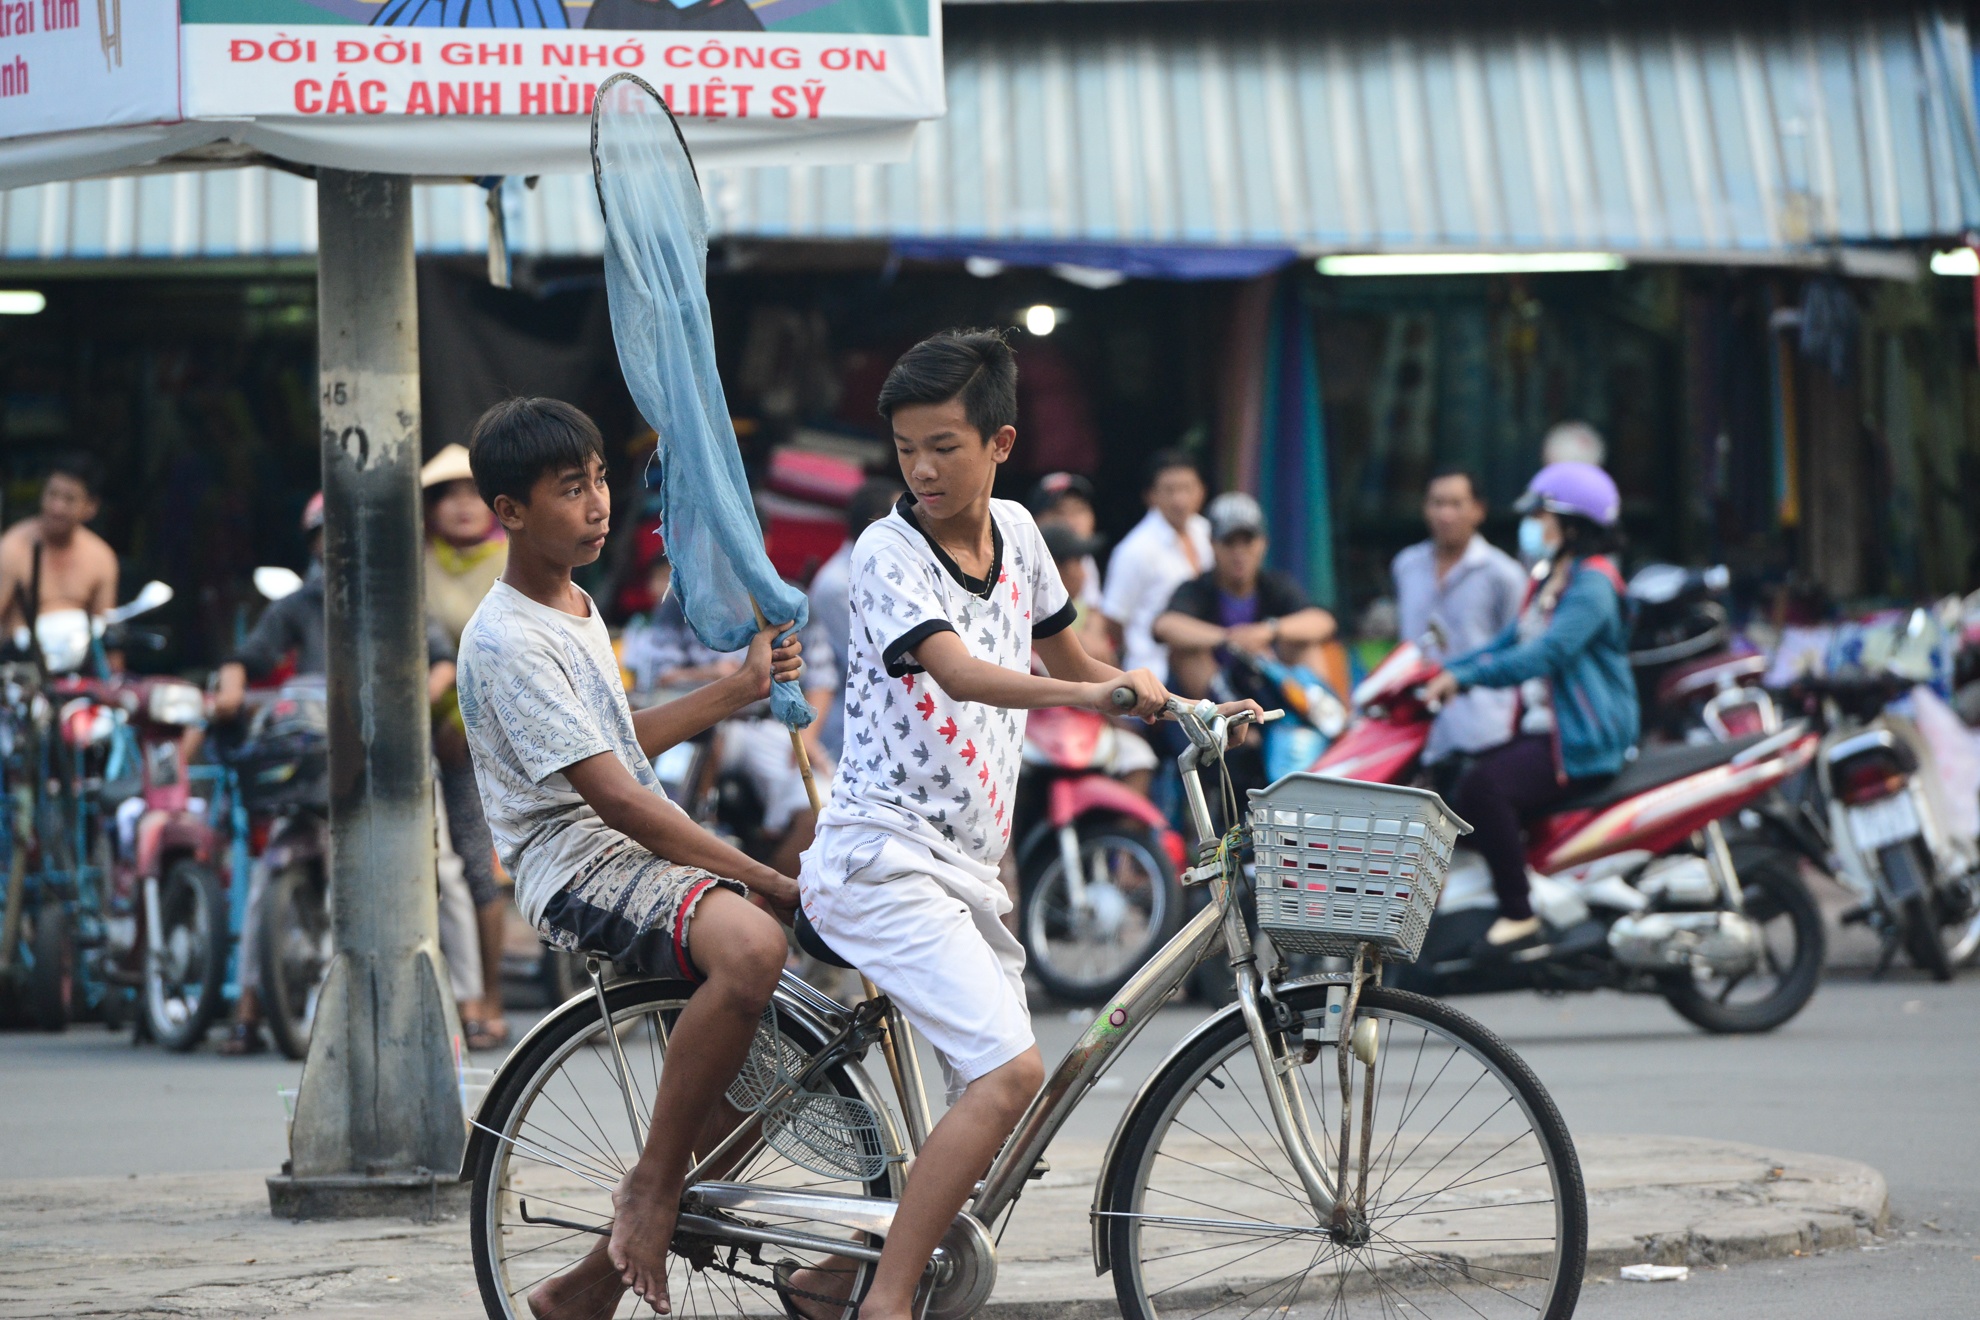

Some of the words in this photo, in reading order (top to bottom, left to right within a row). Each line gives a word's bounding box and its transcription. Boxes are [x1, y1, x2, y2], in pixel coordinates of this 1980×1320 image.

[229, 34, 317, 63] ĐỜI
[336, 34, 422, 65] ĐỜI
[440, 42, 523, 66] GHI
[543, 38, 645, 69] NHỚ
[664, 39, 802, 71] CÔNG
[819, 47, 887, 72] ƠN
[293, 72, 388, 116] CÁC
[405, 80, 502, 116] ANH
[519, 74, 645, 117] HÙNG
[664, 77, 755, 122] LIỆT
[771, 79, 826, 119] SỸ
